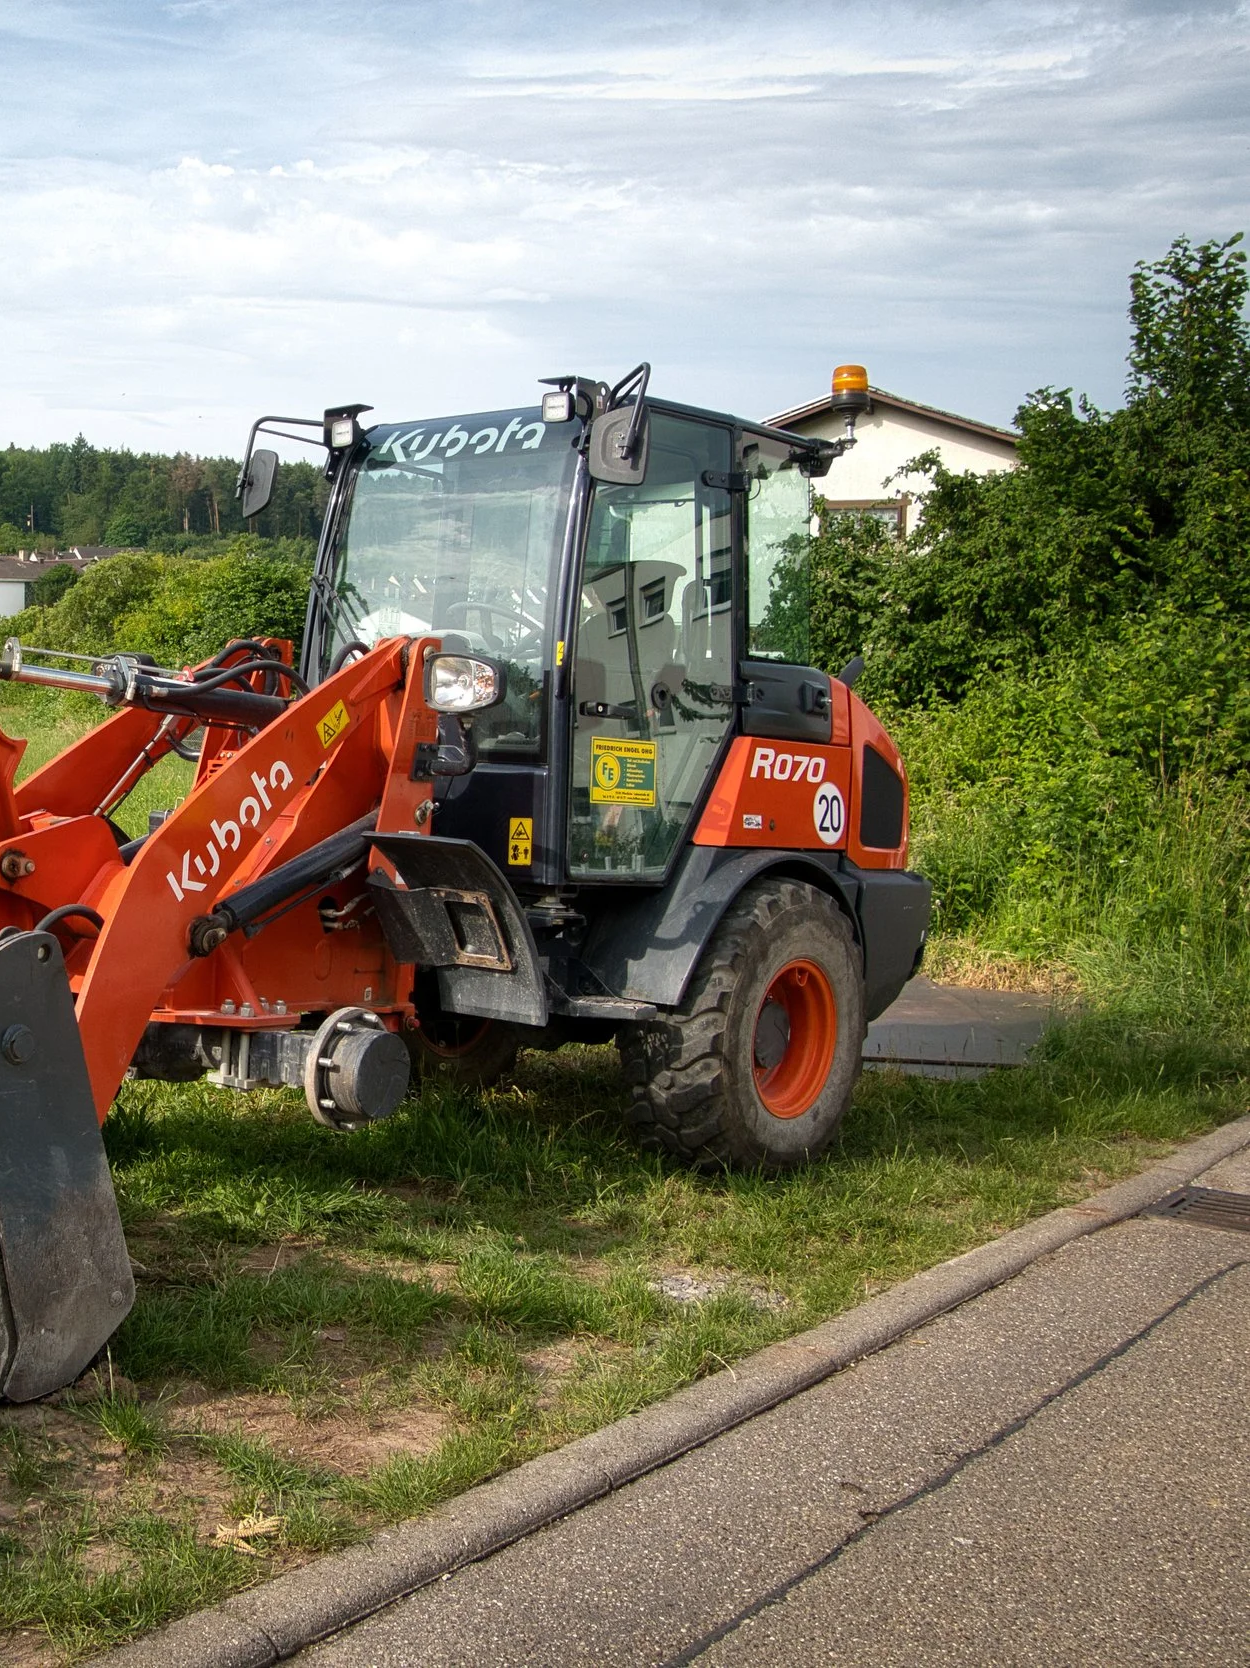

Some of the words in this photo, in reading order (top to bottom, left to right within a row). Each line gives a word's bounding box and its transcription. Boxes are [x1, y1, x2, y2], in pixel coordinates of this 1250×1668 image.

[379, 416, 546, 463] Kubota
[595, 744, 623, 752] FRIEDRICH
[624, 746, 640, 754] ENGEL
[750, 747, 826, 783] R070
[166, 760, 294, 902] Kubota
[818, 794, 841, 833] 20
